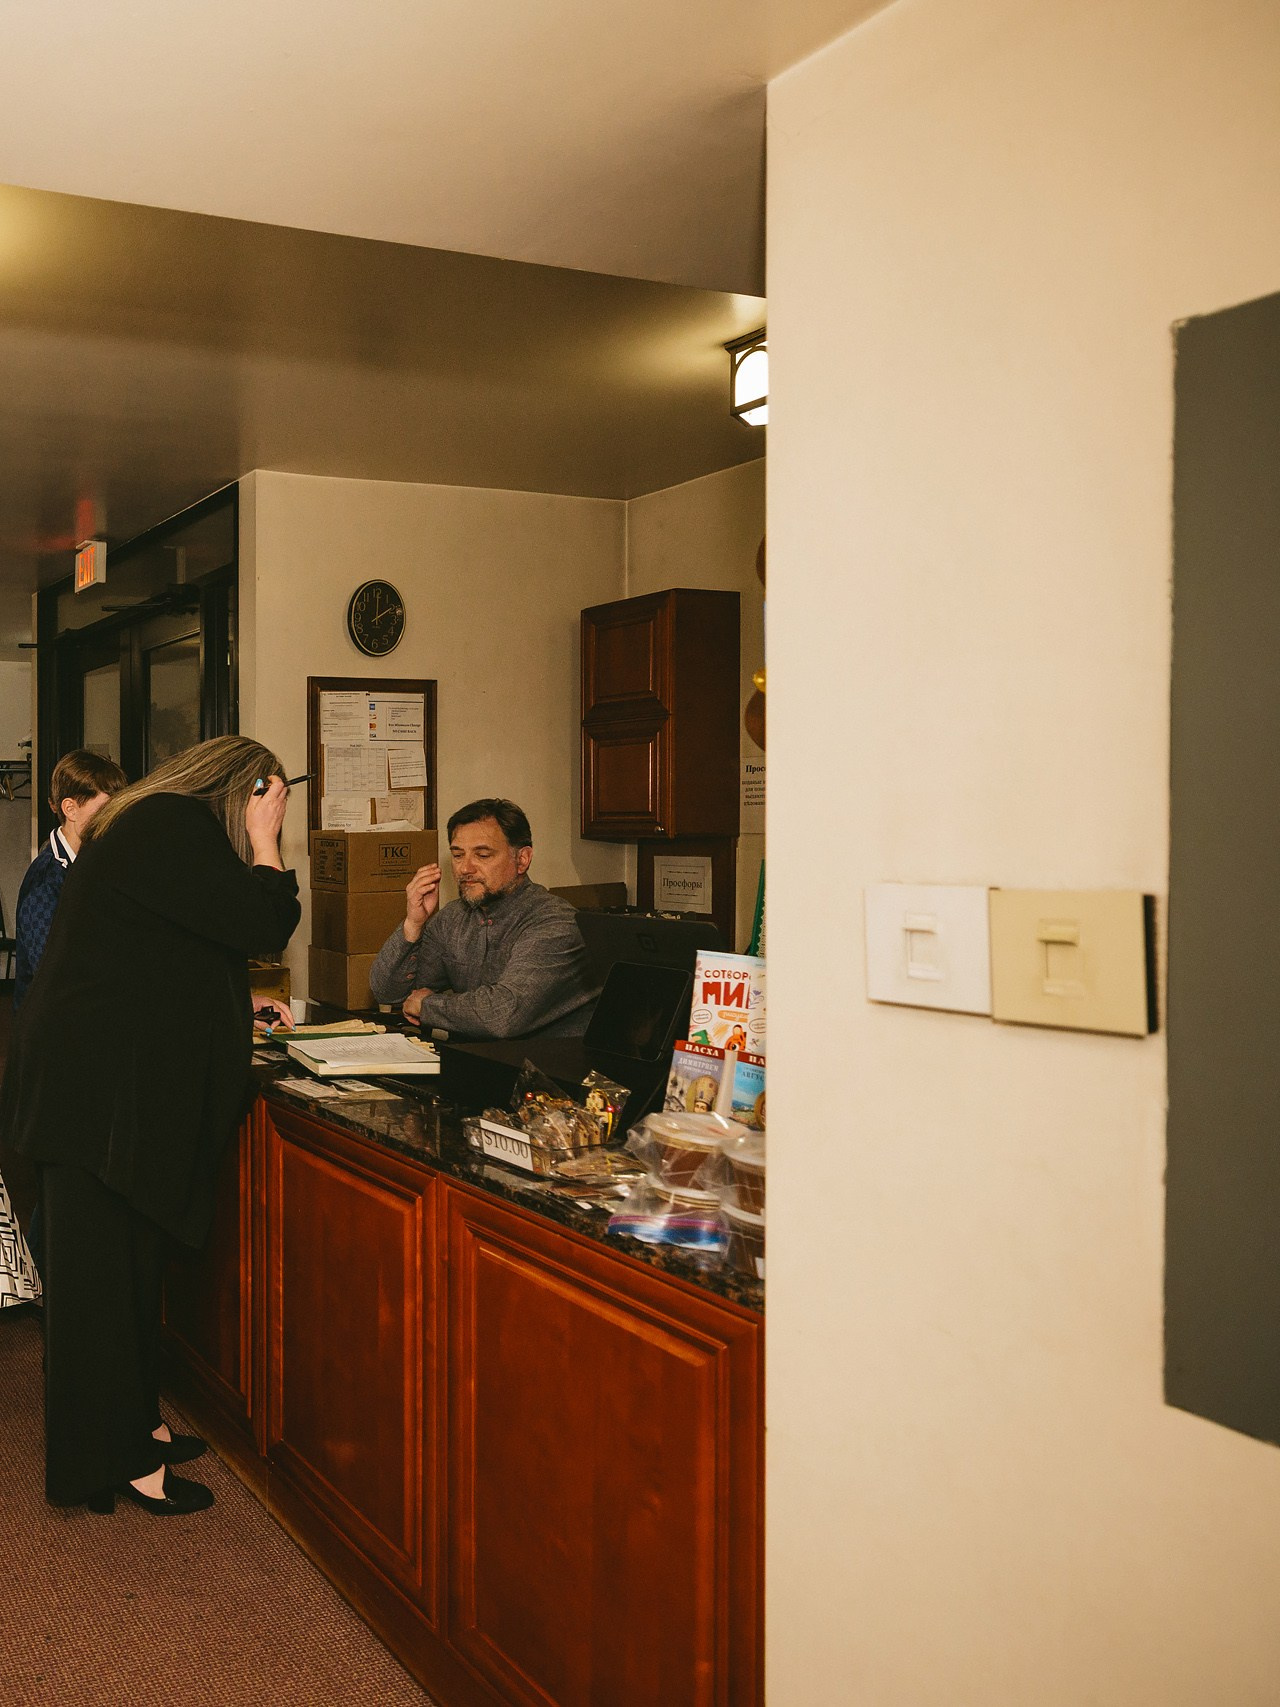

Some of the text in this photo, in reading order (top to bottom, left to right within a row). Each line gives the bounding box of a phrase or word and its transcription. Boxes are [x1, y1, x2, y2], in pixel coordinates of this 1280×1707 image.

[381, 846, 409, 858] TKC
[662, 878, 703, 890] Просфоры
[704, 970, 751, 981] СОТВОР
[685, 1043, 719, 1057] ПАСХА
[484, 1131, 528, 1159] $10.00
